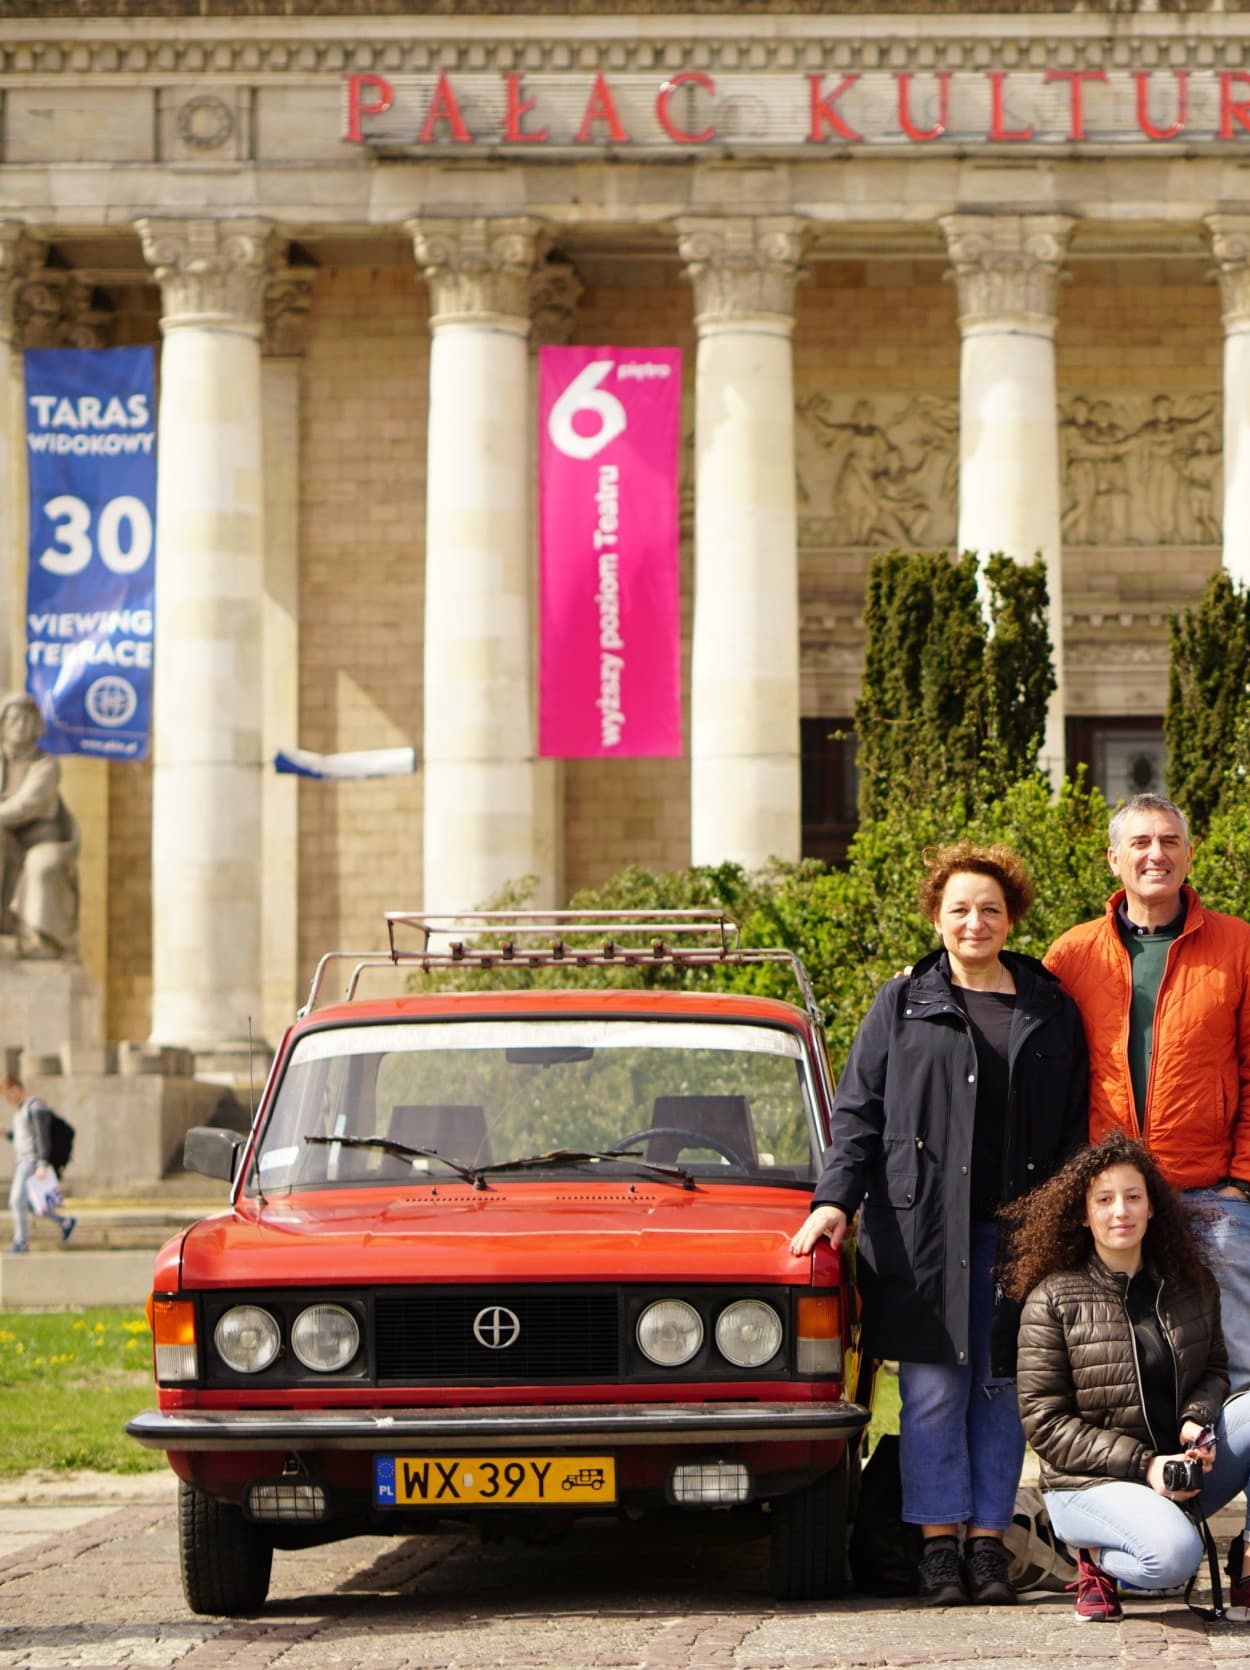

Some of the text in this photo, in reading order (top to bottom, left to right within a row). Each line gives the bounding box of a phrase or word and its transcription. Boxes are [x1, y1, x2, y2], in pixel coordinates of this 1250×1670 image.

[342, 69, 718, 145] PAŁAC
[27, 432, 155, 456] WIDOKOWY
[29, 394, 150, 429] TARAS
[548, 360, 627, 460] 6
[39, 494, 153, 576] 30
[593, 464, 620, 550] Teatru
[29, 609, 153, 637] VIEWING
[595, 554, 624, 650] poziom
[379, 1461, 552, 1499] PL WX 39Y
